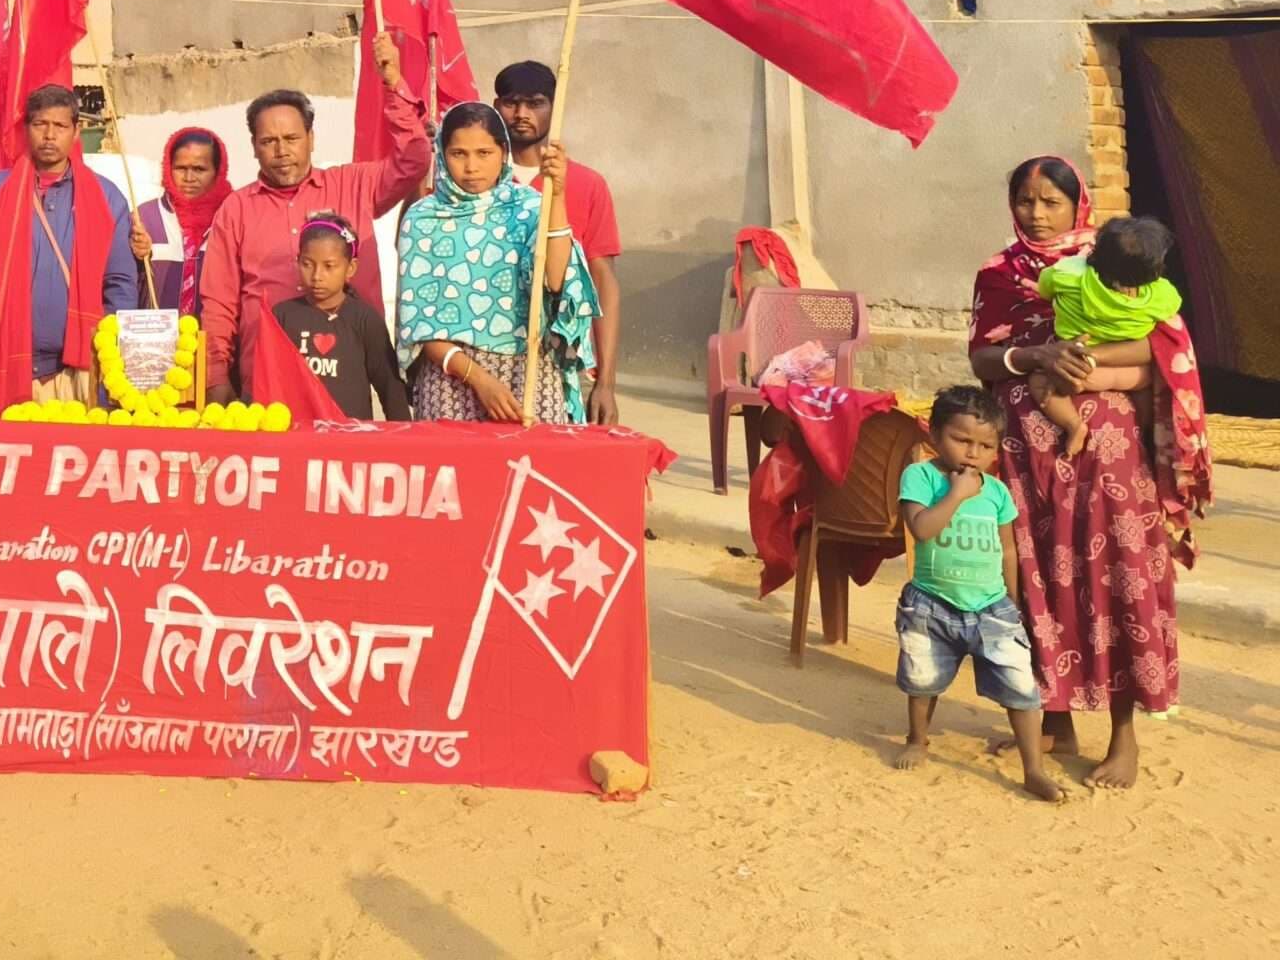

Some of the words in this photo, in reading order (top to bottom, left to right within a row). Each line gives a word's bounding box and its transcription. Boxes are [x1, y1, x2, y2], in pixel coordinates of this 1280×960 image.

[305, 356, 338, 377] OM
[304, 459, 464, 521] INDIA
[86, 524, 190, 581] CPI(M-L)
[203, 536, 389, 582] Libaration
[310, 725, 469, 768] झारखण्ड
